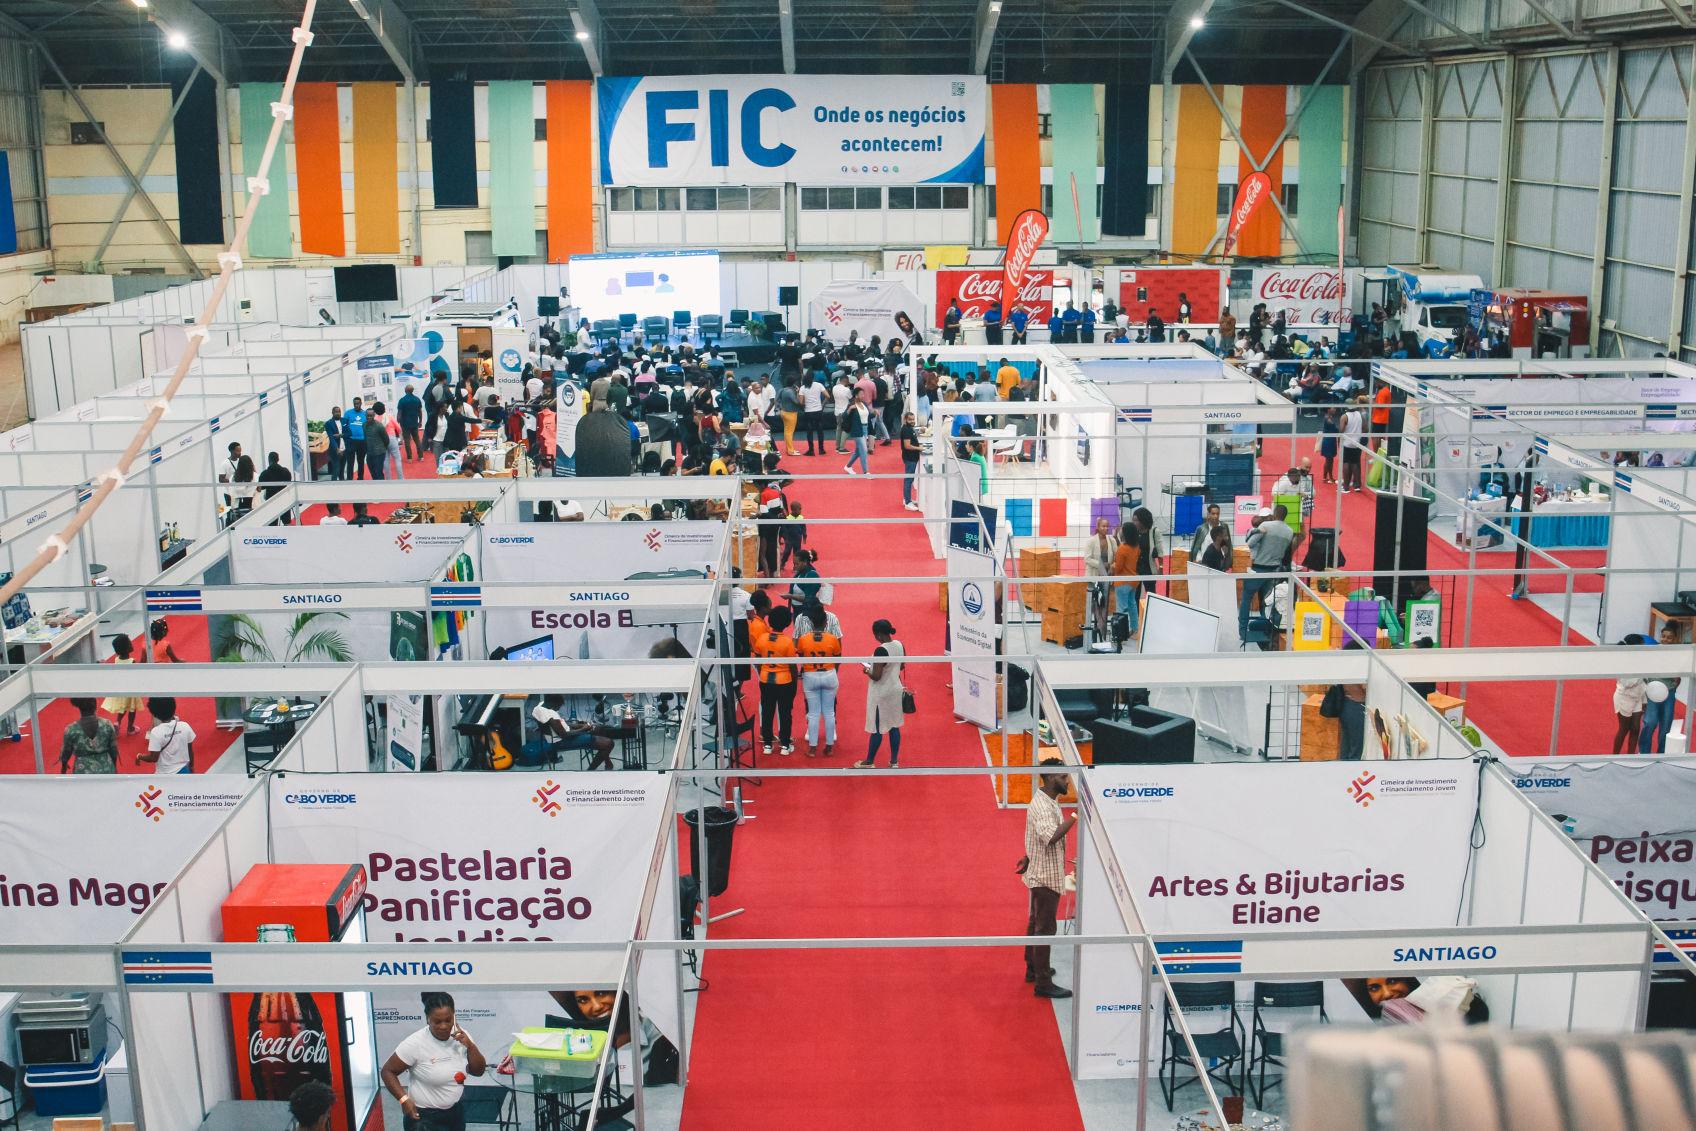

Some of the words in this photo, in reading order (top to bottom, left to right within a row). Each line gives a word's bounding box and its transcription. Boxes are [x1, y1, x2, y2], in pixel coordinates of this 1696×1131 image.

[814, 105, 860, 123] Onde
[865, 110, 884, 123] os
[888, 104, 966, 127] negócios
[645, 87, 797, 168] FIC
[841, 135, 943, 152] acontecem!
[283, 594, 342, 604] SANTIAGO
[569, 592, 630, 601] SANTIAGO
[531, 609, 611, 629] Escola
[1535, 778, 1571, 787] VERDE
[318, 794, 357, 803] VERDE
[1136, 787, 1174, 797] VERDE
[369, 847, 572, 881] Pastelaria
[1149, 875, 1229, 897] Artes
[1235, 873, 1256, 895] &
[1265, 868, 1405, 899] Bijutarias
[362, 887, 592, 928] Panificação
[1232, 900, 1320, 924] Eliane
[1393, 945, 1497, 962] SANTIAGO
[366, 961, 473, 976] SANTIAGO
[249, 1030, 328, 1064] Coca-Cola
